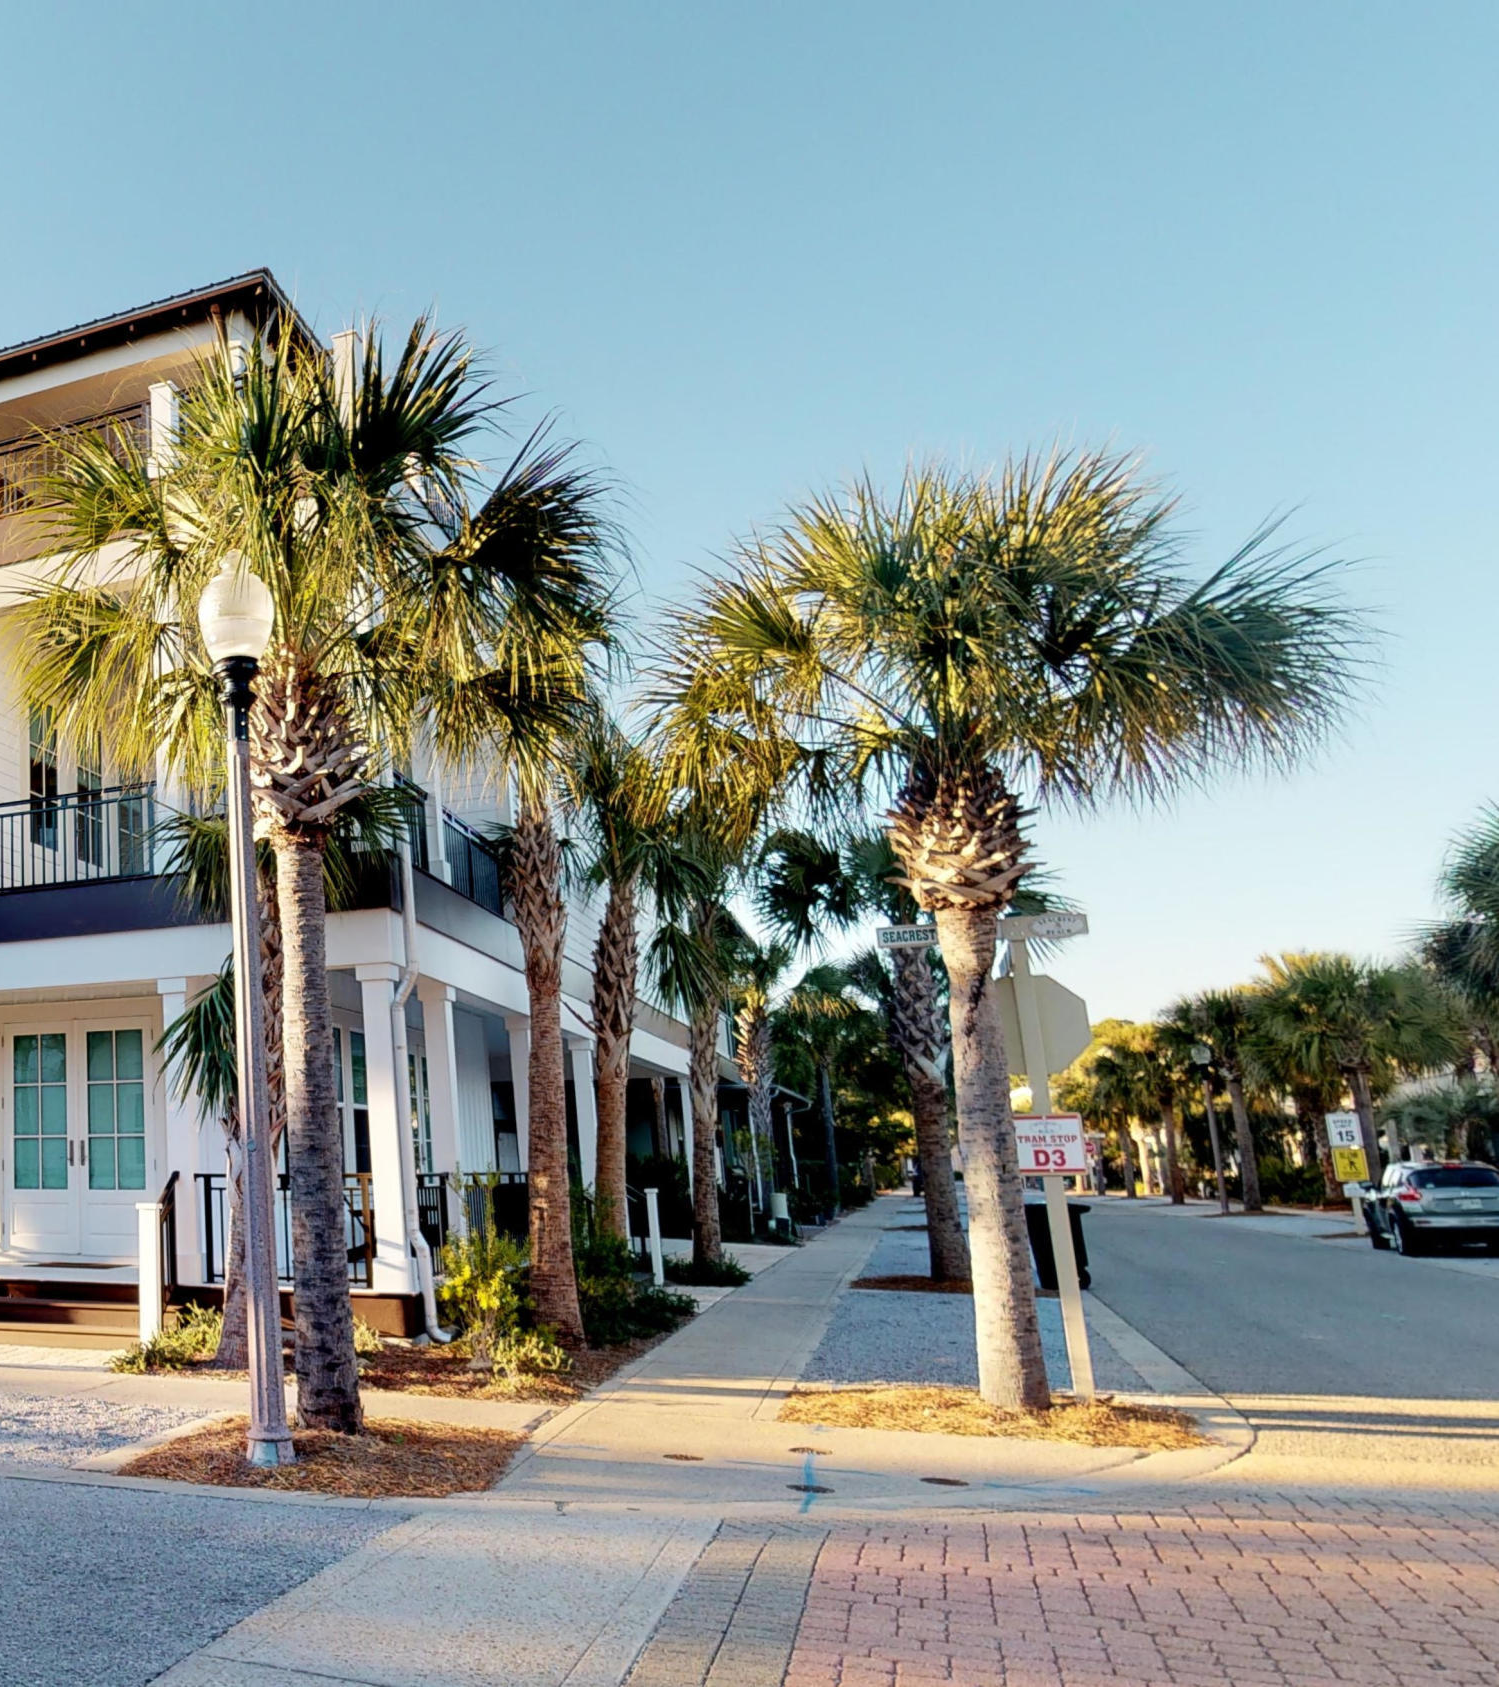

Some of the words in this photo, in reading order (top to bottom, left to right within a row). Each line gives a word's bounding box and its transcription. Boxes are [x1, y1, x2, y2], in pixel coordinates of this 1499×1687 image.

[882, 929, 936, 944] SEACREST
[1016, 1135, 1047, 1144] TRAM
[1050, 1135, 1078, 1144] STOP
[1336, 1130, 1356, 1142] 15
[1033, 1149, 1067, 1168] D3
